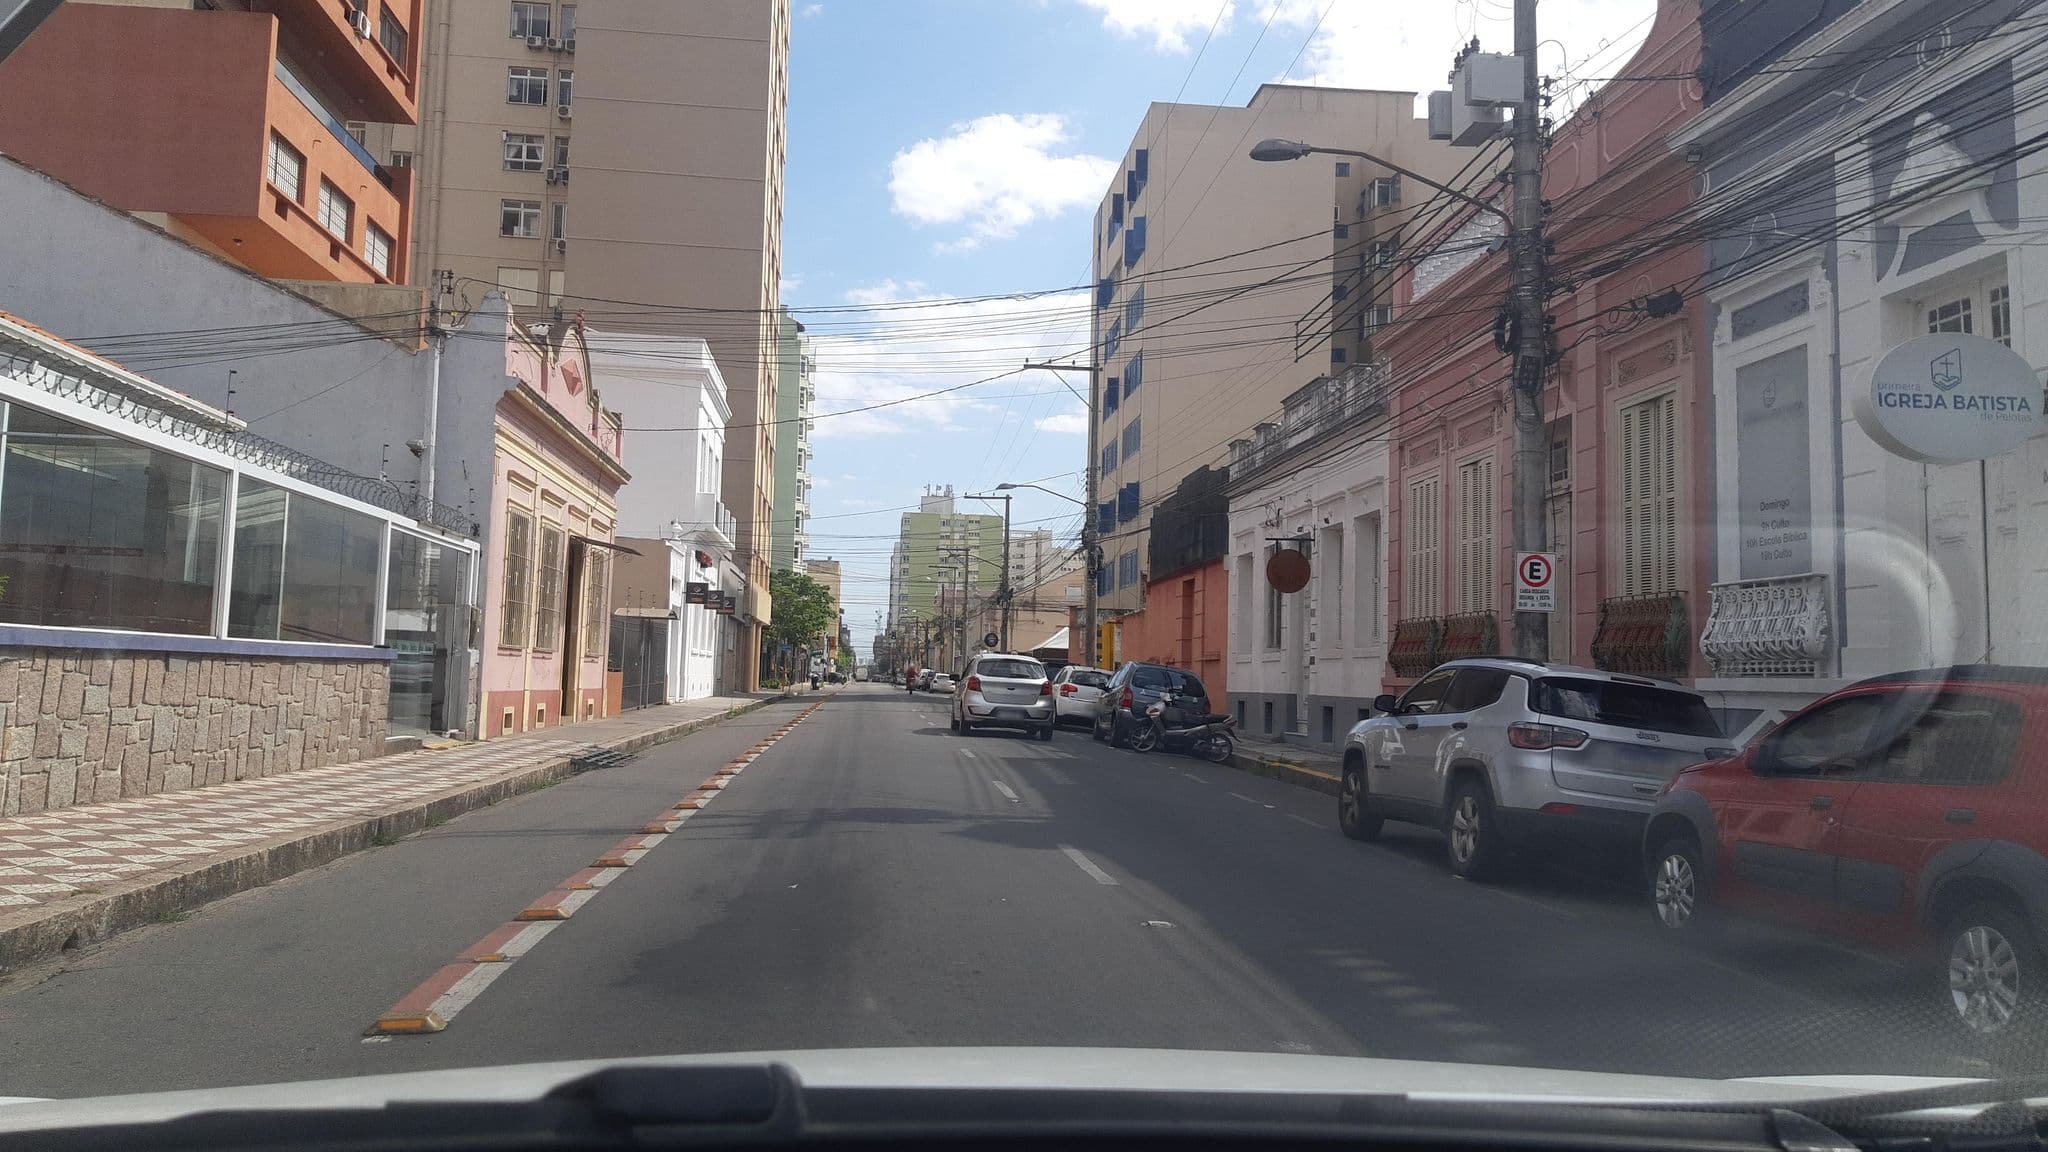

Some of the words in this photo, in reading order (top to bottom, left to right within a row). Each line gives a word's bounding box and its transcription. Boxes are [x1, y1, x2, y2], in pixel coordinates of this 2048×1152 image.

[1878, 392, 1947, 409] IGREJA
[1954, 395, 2030, 411] BATISTA
[1529, 562, 1541, 579] E
